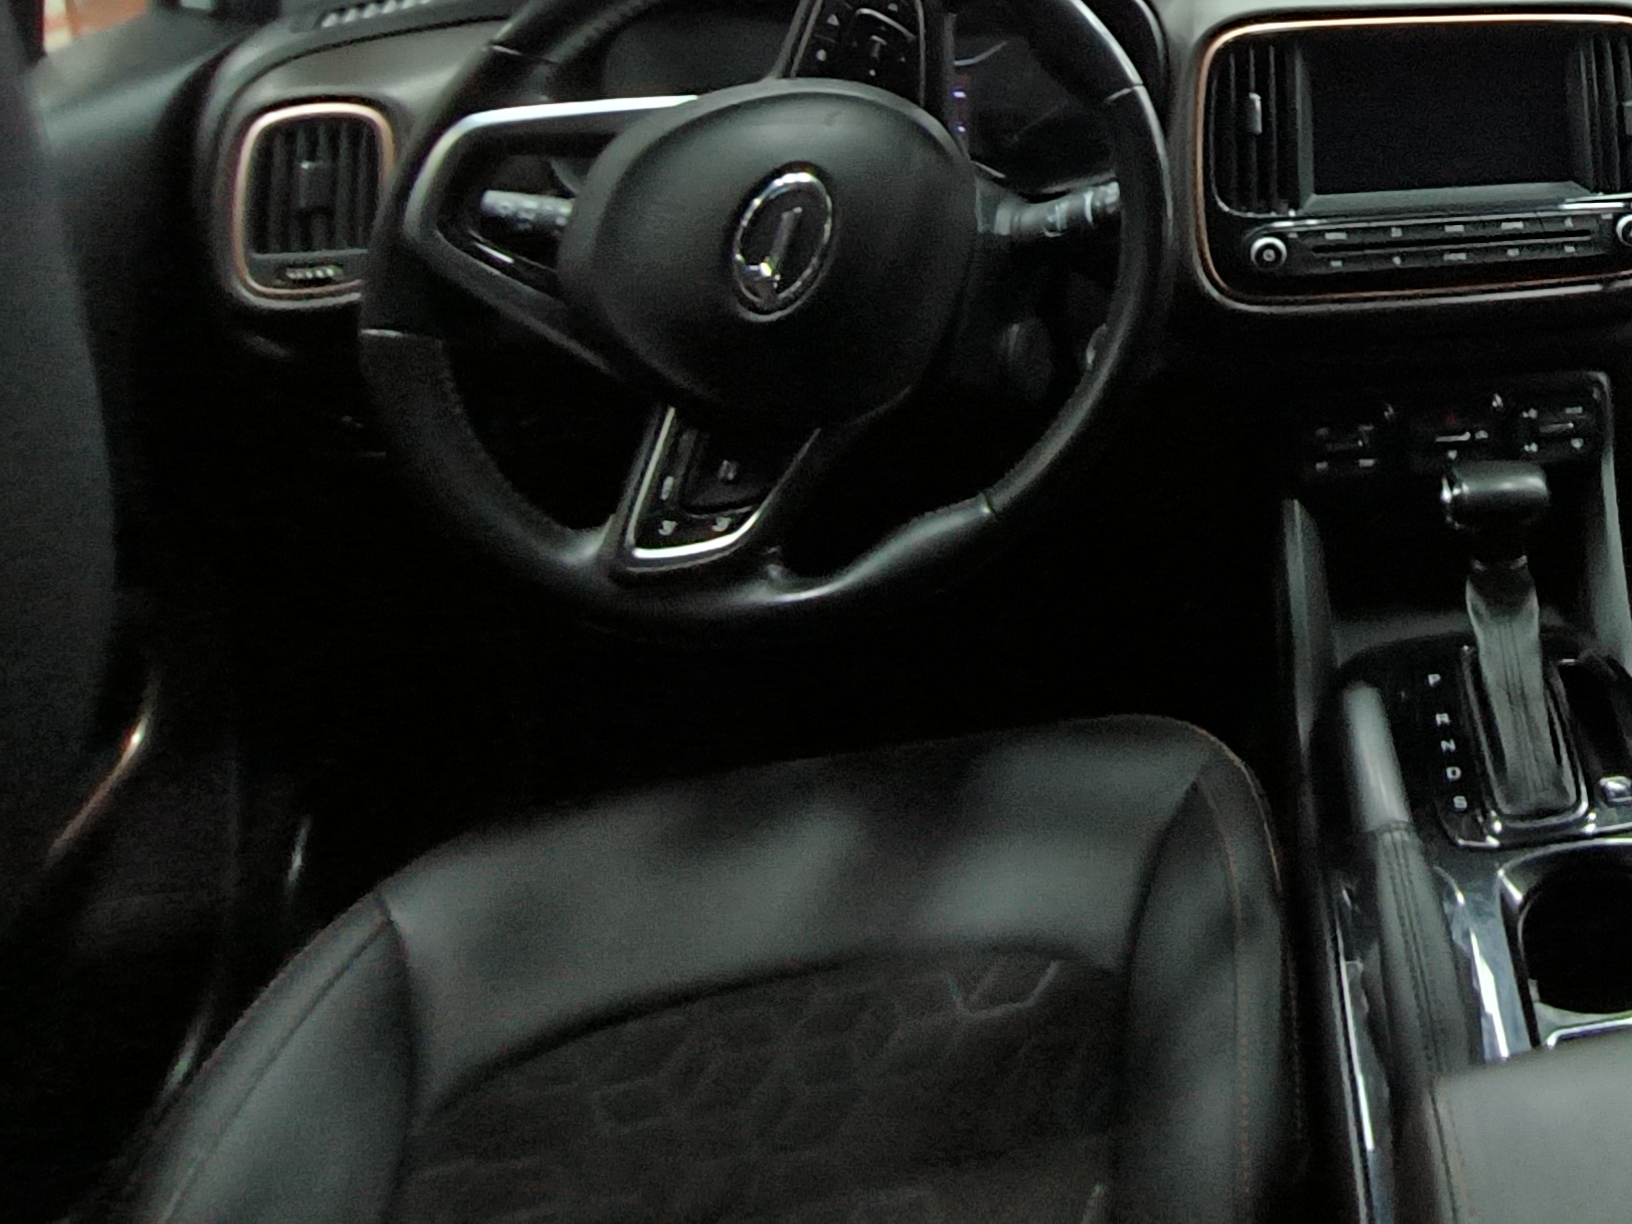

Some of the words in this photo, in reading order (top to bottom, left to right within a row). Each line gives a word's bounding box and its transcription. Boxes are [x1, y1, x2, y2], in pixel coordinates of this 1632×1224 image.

[1428, 673, 1441, 687] P
[1435, 712, 1451, 726] R
[1440, 738, 1456, 752] N
[1446, 766, 1462, 781] D
